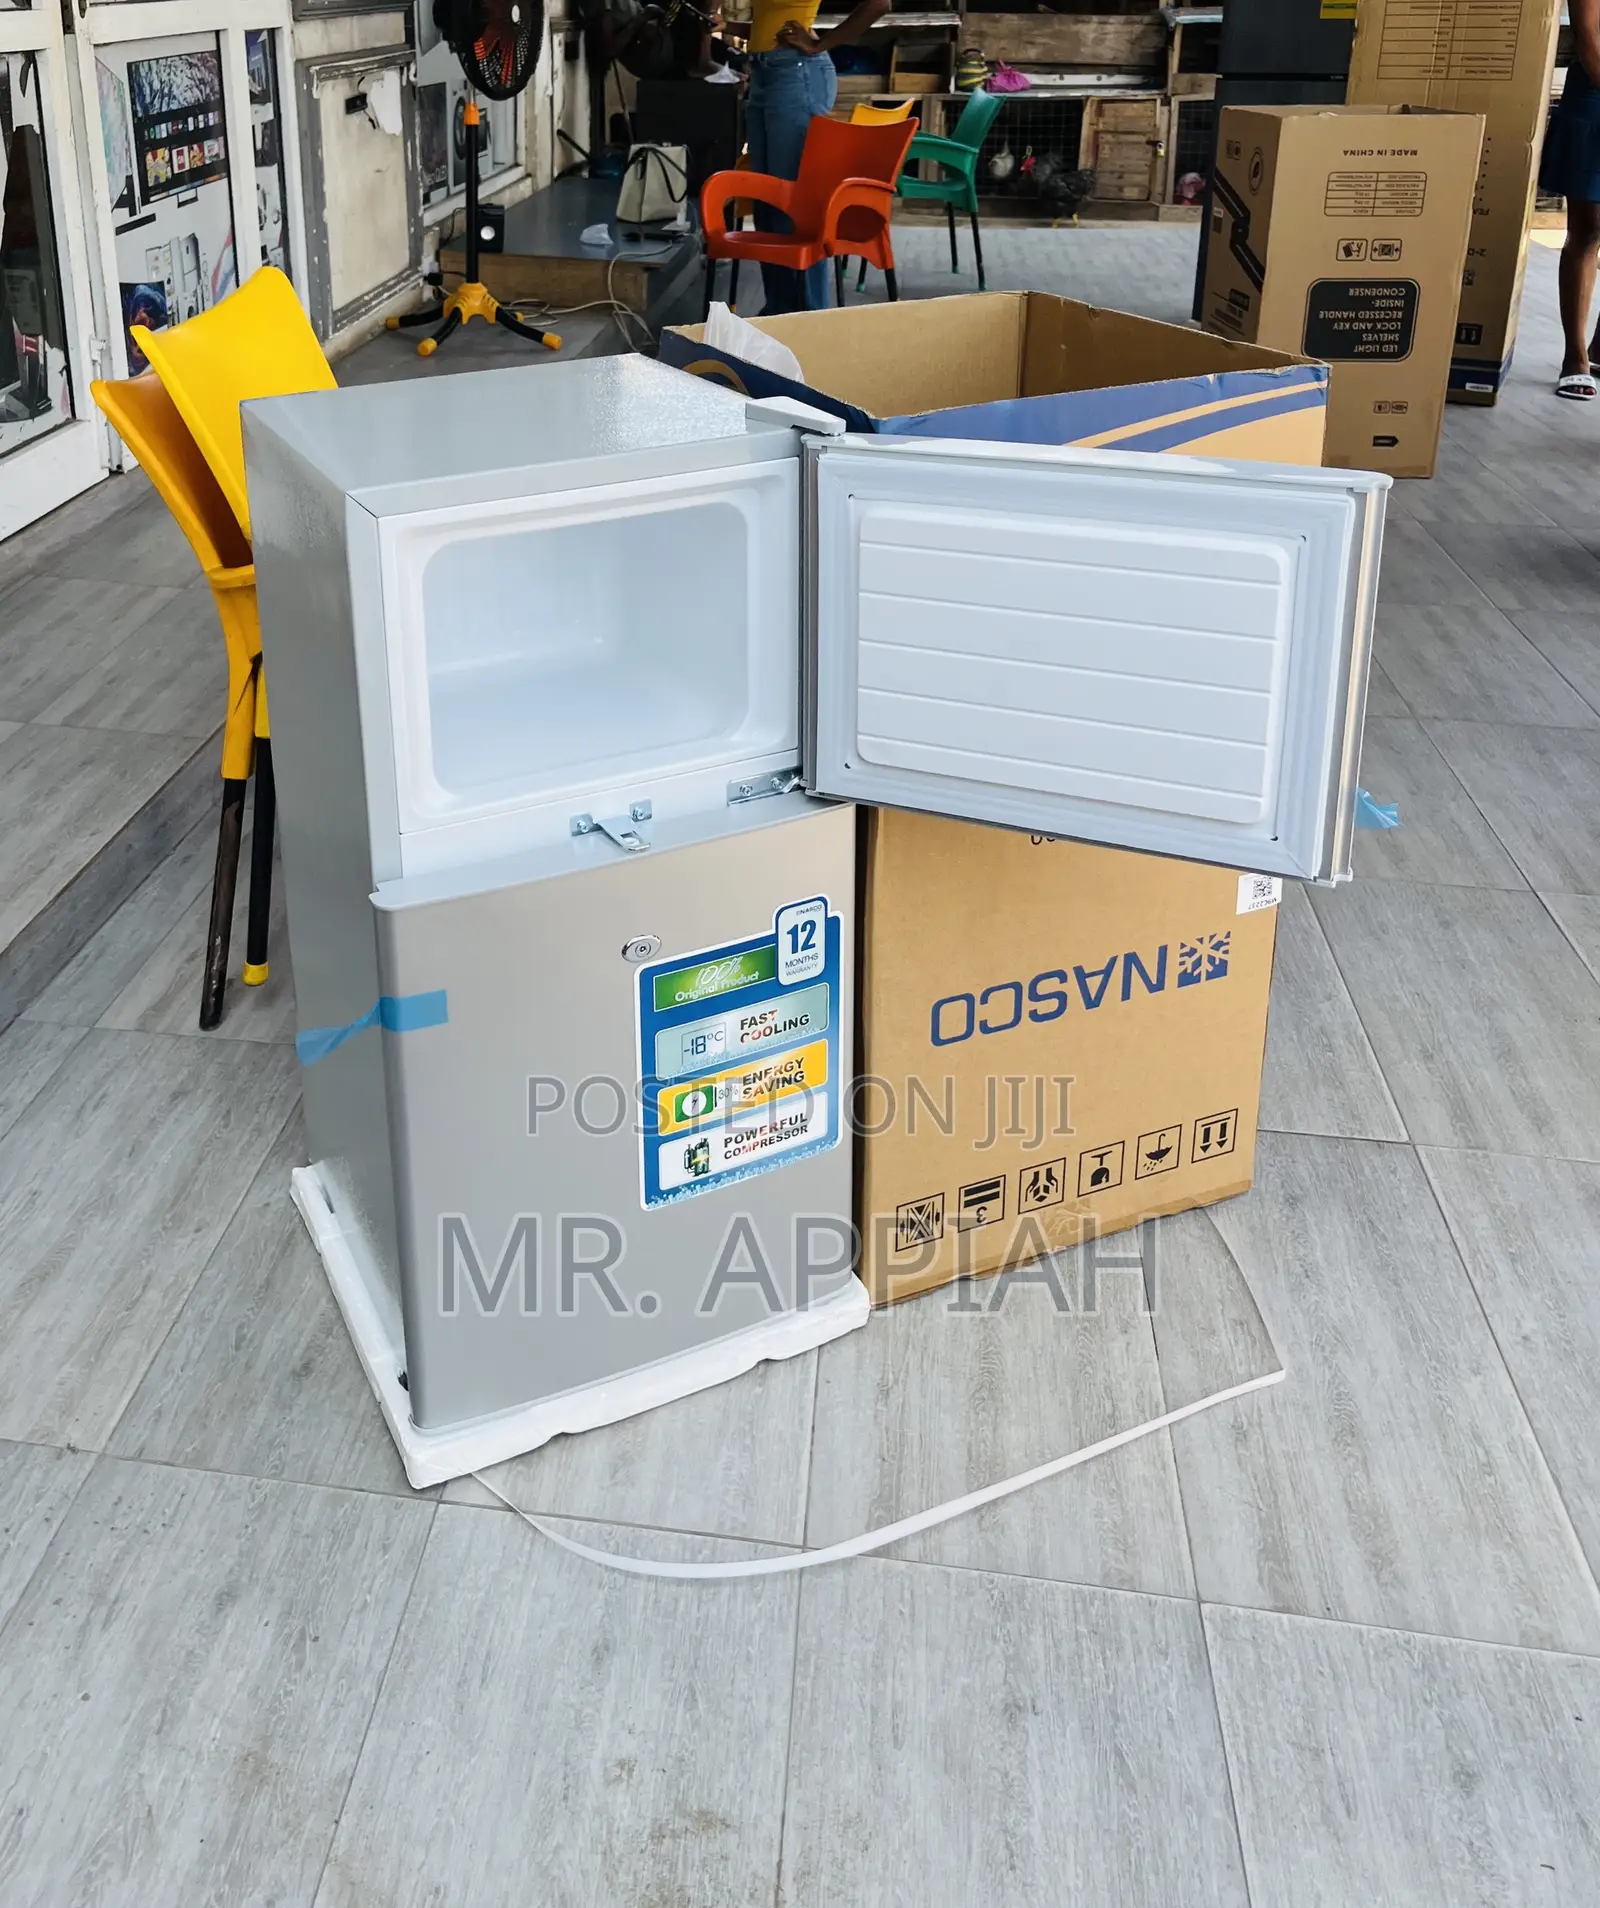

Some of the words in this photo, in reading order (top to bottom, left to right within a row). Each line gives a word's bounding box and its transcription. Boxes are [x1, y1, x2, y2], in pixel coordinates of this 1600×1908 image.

[1349, 288, 1406, 296] CONDENSER
[1319, 310, 1355, 319] HANDLE
[1358, 310, 1403, 319] RECESSED
[1333, 322, 1350, 330] KEY
[1353, 322, 1373, 330] AND
[1376, 322, 1402, 330] LOCK
[1362, 333, 1400, 342] SHELVES
[1354, 344, 1379, 353] LIGHT
[1382, 344, 1398, 353] LED
[800, 904, 823, 915] NASCO
[786, 919, 817, 955] 12
[785, 952, 819, 968] MONTHS
[695, 956, 743, 988] 100%
[785, 963, 818, 977] WARRANTY
[675, 983, 718, 1002] Original
[721, 971, 760, 990] Product
[930, 944, 1168, 1047] NASCO
[739, 1009, 778, 1031] FAST
[740, 1014, 810, 1044] COOLING
[742, 1057, 805, 1087] ENERGY
[742, 1070, 805, 1099] SAVING
[718, 1085, 739, 1100] 30%
[723, 1113, 808, 1148] POWERFUL
[723, 1124, 809, 1160] COMPRESSOR
[974, 1205, 988, 1224] 3
